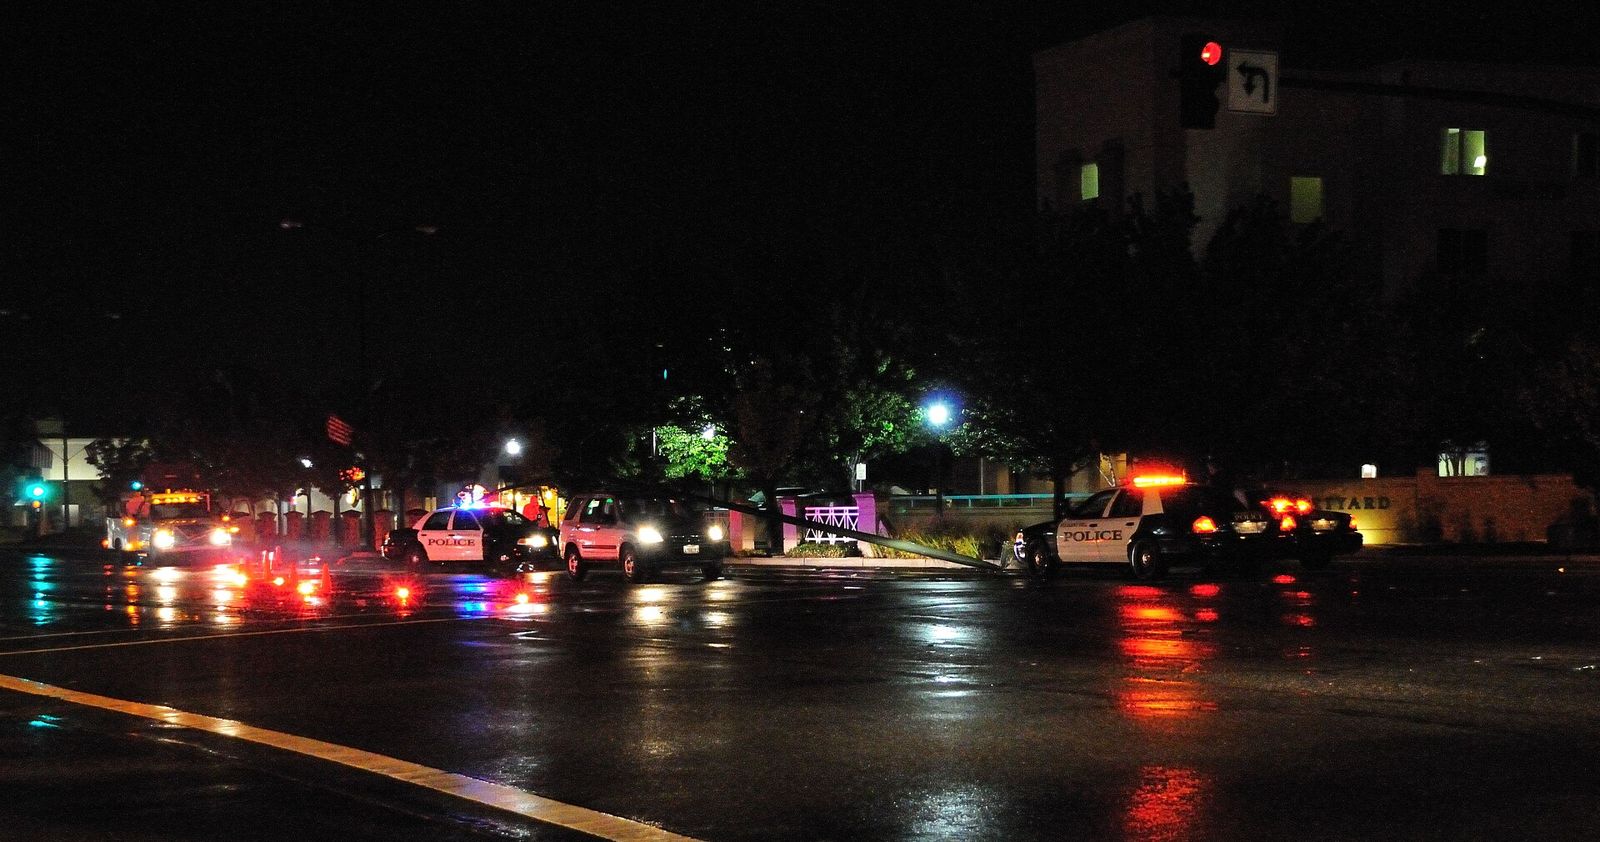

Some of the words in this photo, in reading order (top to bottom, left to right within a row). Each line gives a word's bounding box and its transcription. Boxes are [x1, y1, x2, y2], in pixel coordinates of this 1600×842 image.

[1317, 496, 1392, 510] TYARD
[1063, 529, 1123, 542] POLICE
[427, 538, 476, 547] POLICE
